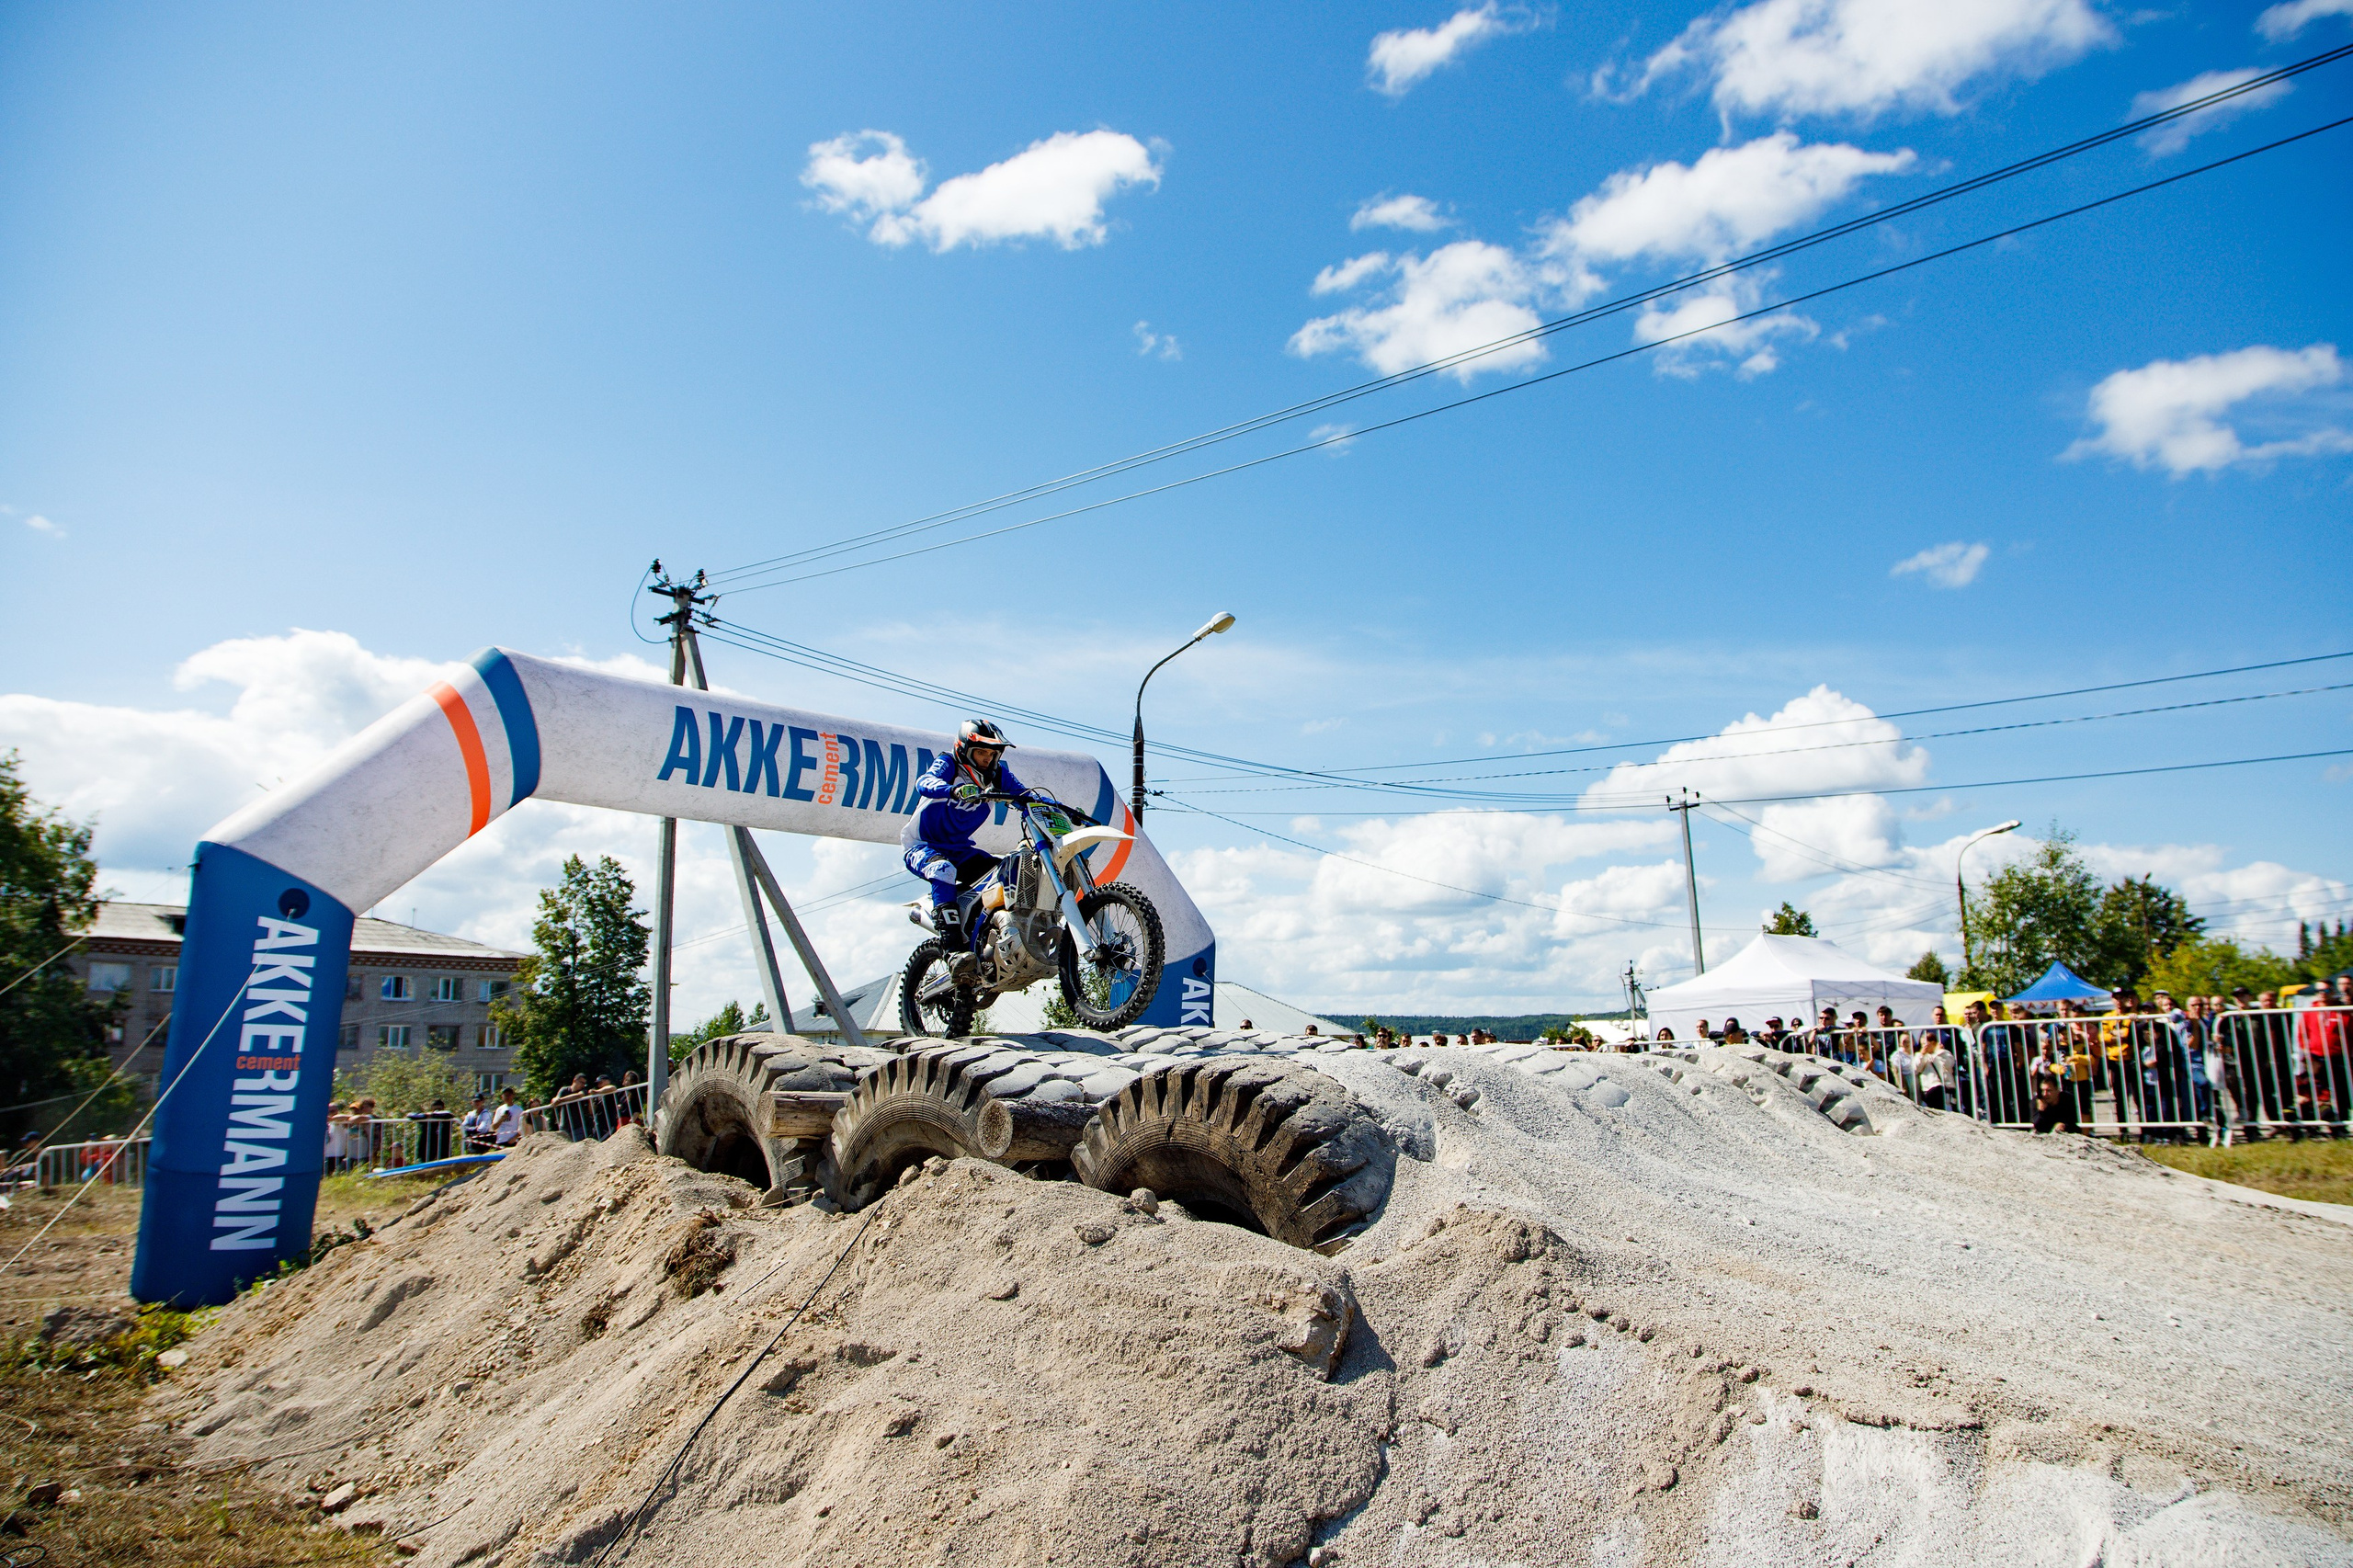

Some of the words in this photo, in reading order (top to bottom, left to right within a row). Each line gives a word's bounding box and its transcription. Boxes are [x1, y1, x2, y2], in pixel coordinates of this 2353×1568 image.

[817, 732, 837, 805] cement
[210, 915, 321, 1251] AKKERMANN
[236, 1053, 301, 1072] cement
